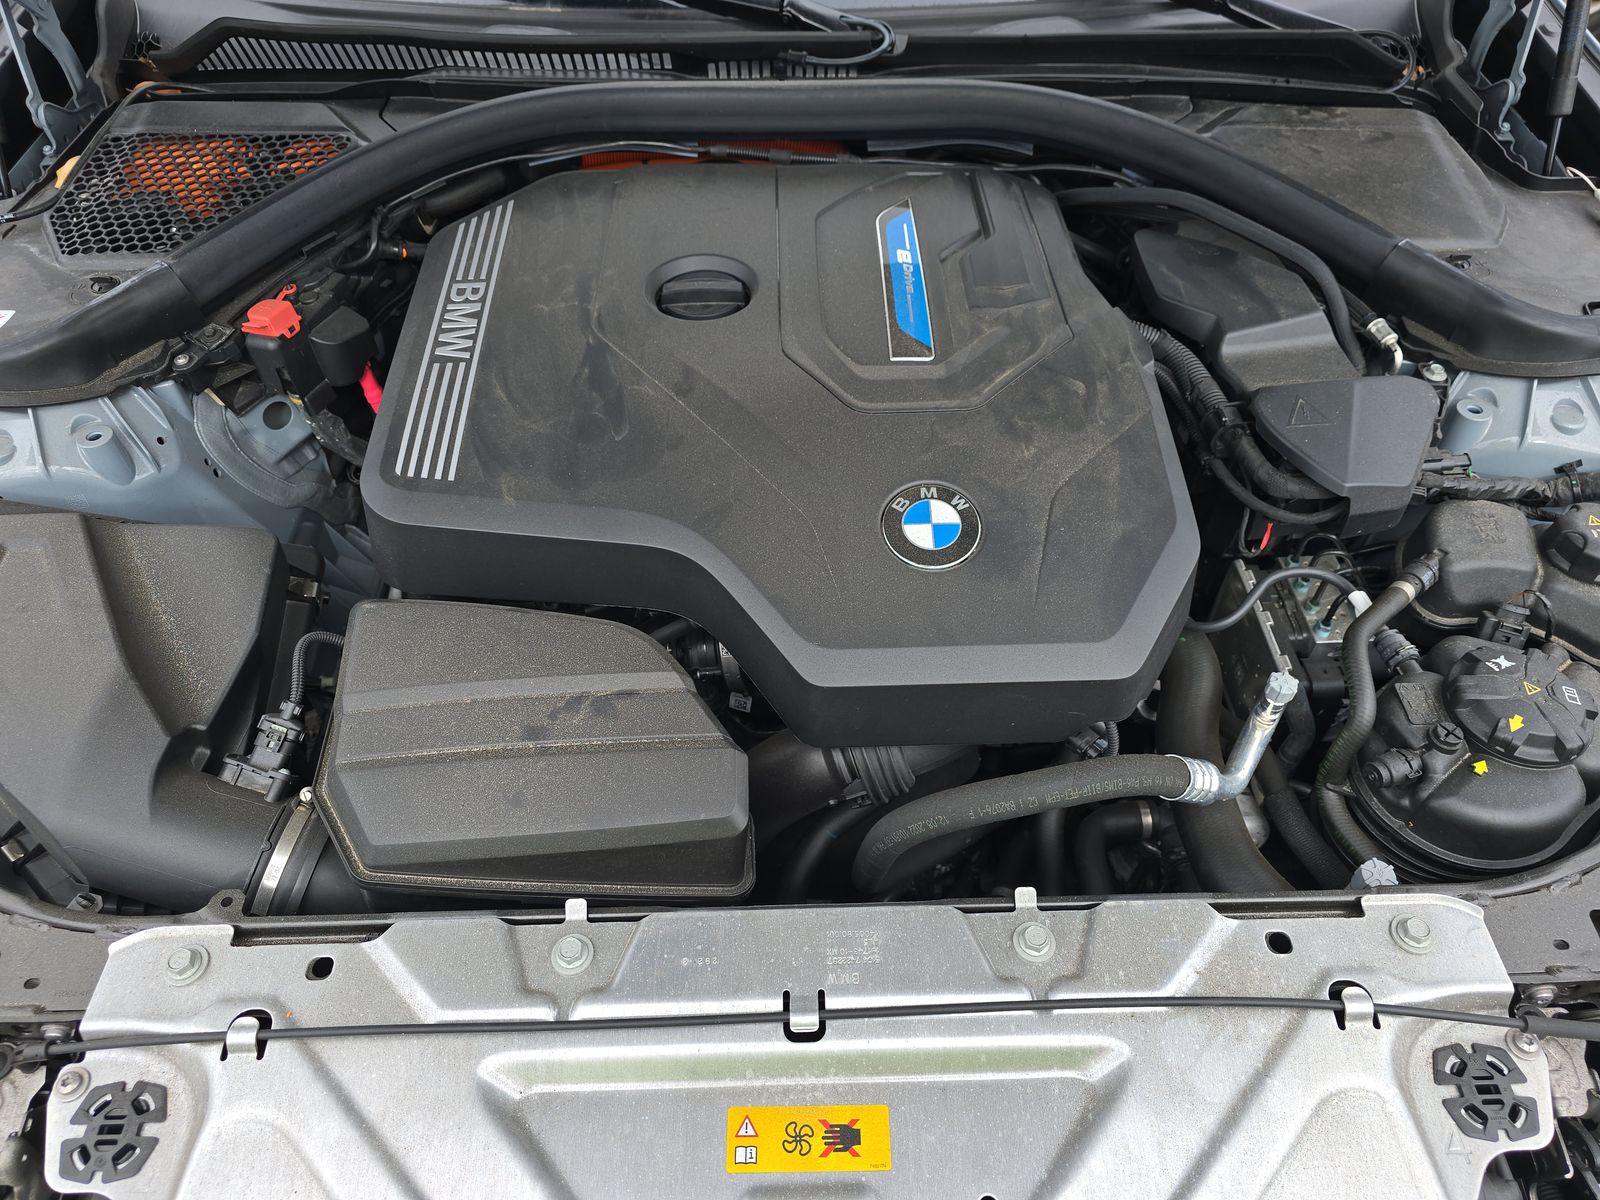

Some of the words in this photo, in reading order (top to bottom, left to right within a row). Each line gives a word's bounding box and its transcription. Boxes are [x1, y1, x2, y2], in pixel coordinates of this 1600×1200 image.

[434, 281, 487, 359] BMW
[891, 486, 970, 513] BMW
[827, 972, 860, 985] BMW
